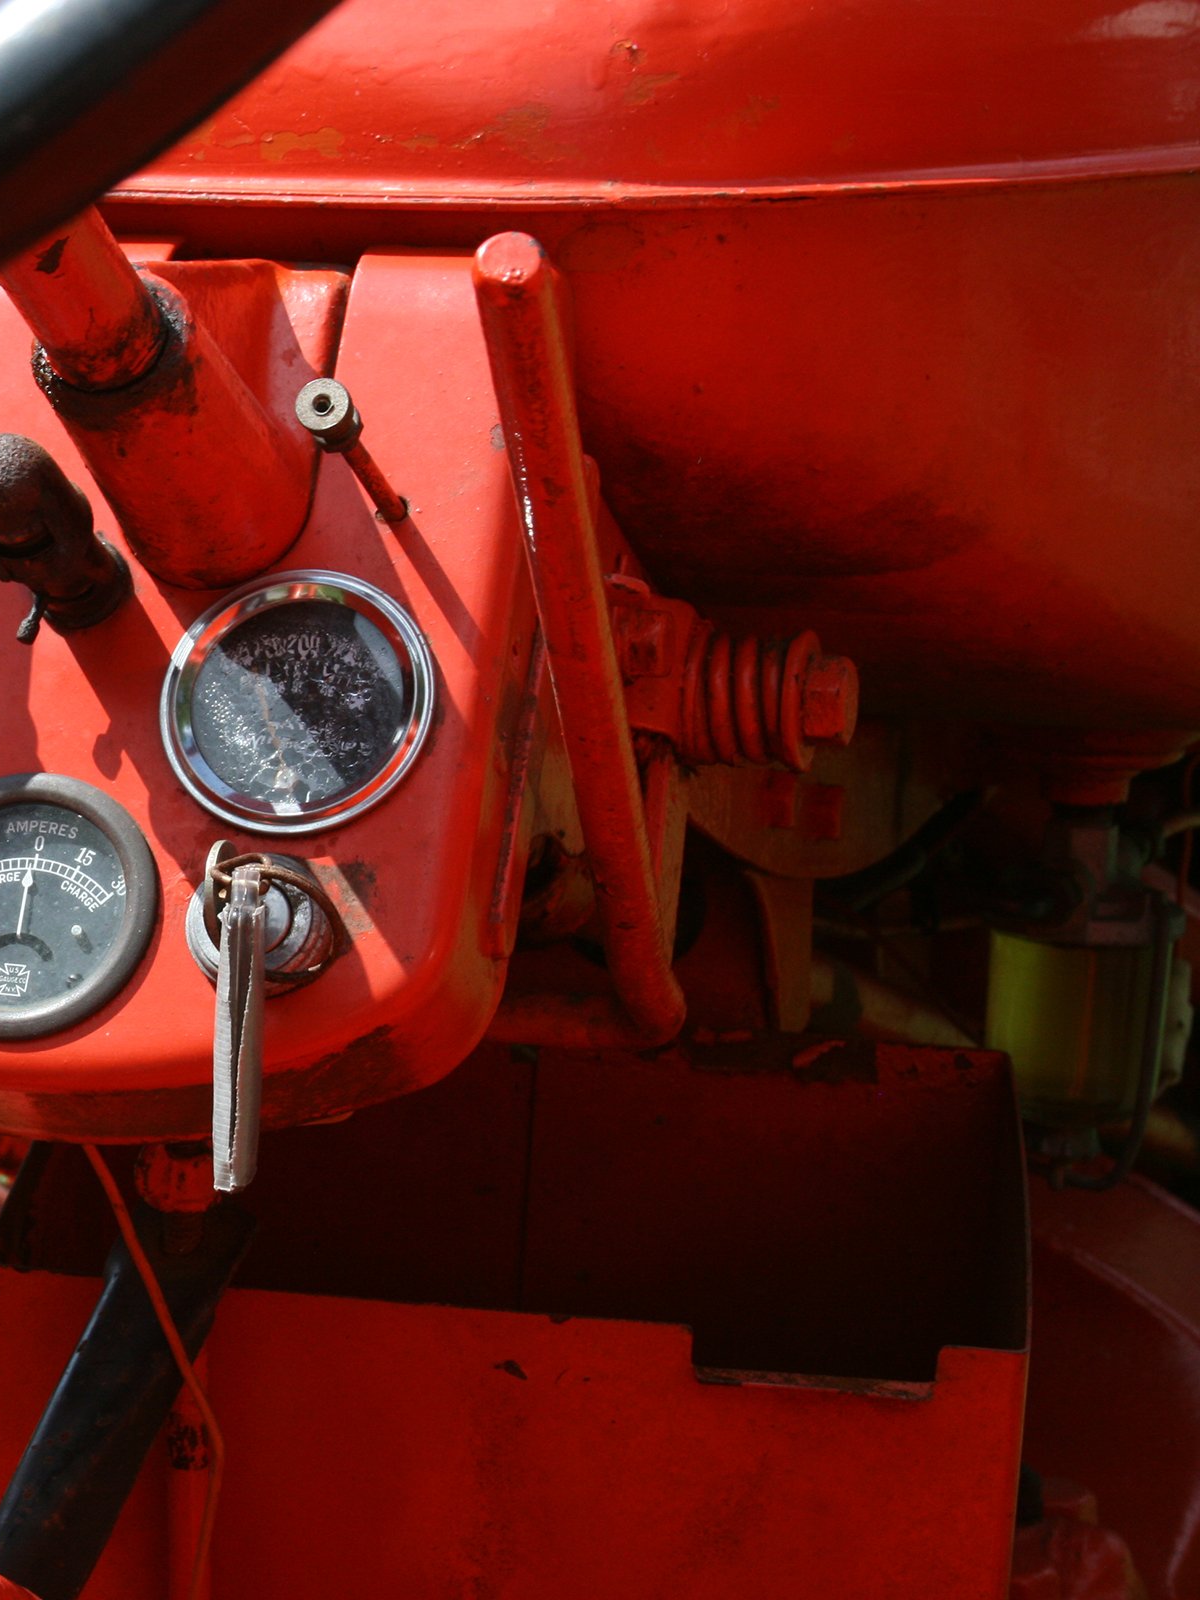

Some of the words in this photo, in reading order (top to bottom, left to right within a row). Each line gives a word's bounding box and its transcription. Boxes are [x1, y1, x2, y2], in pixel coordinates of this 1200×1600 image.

[6, 820, 79, 839] AMPERES
[34, 835, 45, 851] 0
[73, 847, 96, 866] 15
[60, 880, 100, 912] CHARGE
